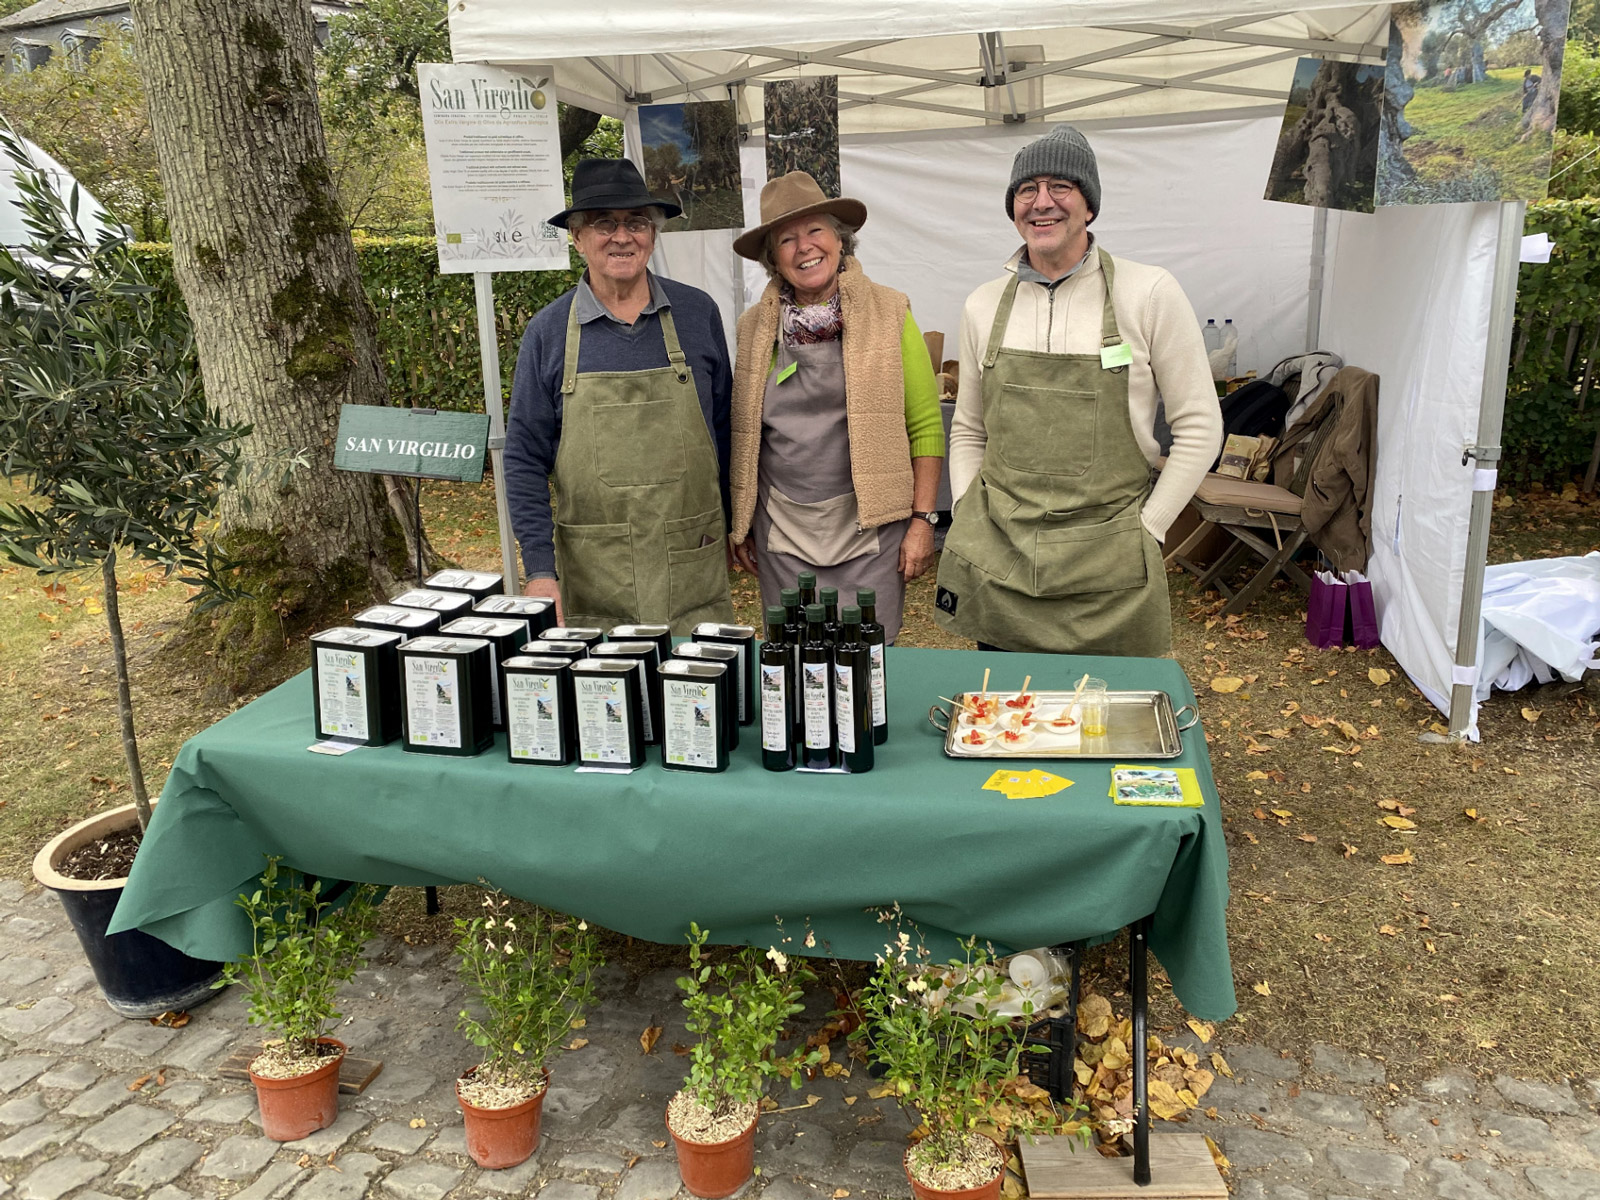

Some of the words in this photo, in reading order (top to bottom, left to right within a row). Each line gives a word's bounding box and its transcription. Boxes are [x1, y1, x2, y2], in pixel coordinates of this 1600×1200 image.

[430, 78, 465, 110] San
[345, 436, 382, 453] SAN
[387, 438, 475, 460] VIRGILIO
